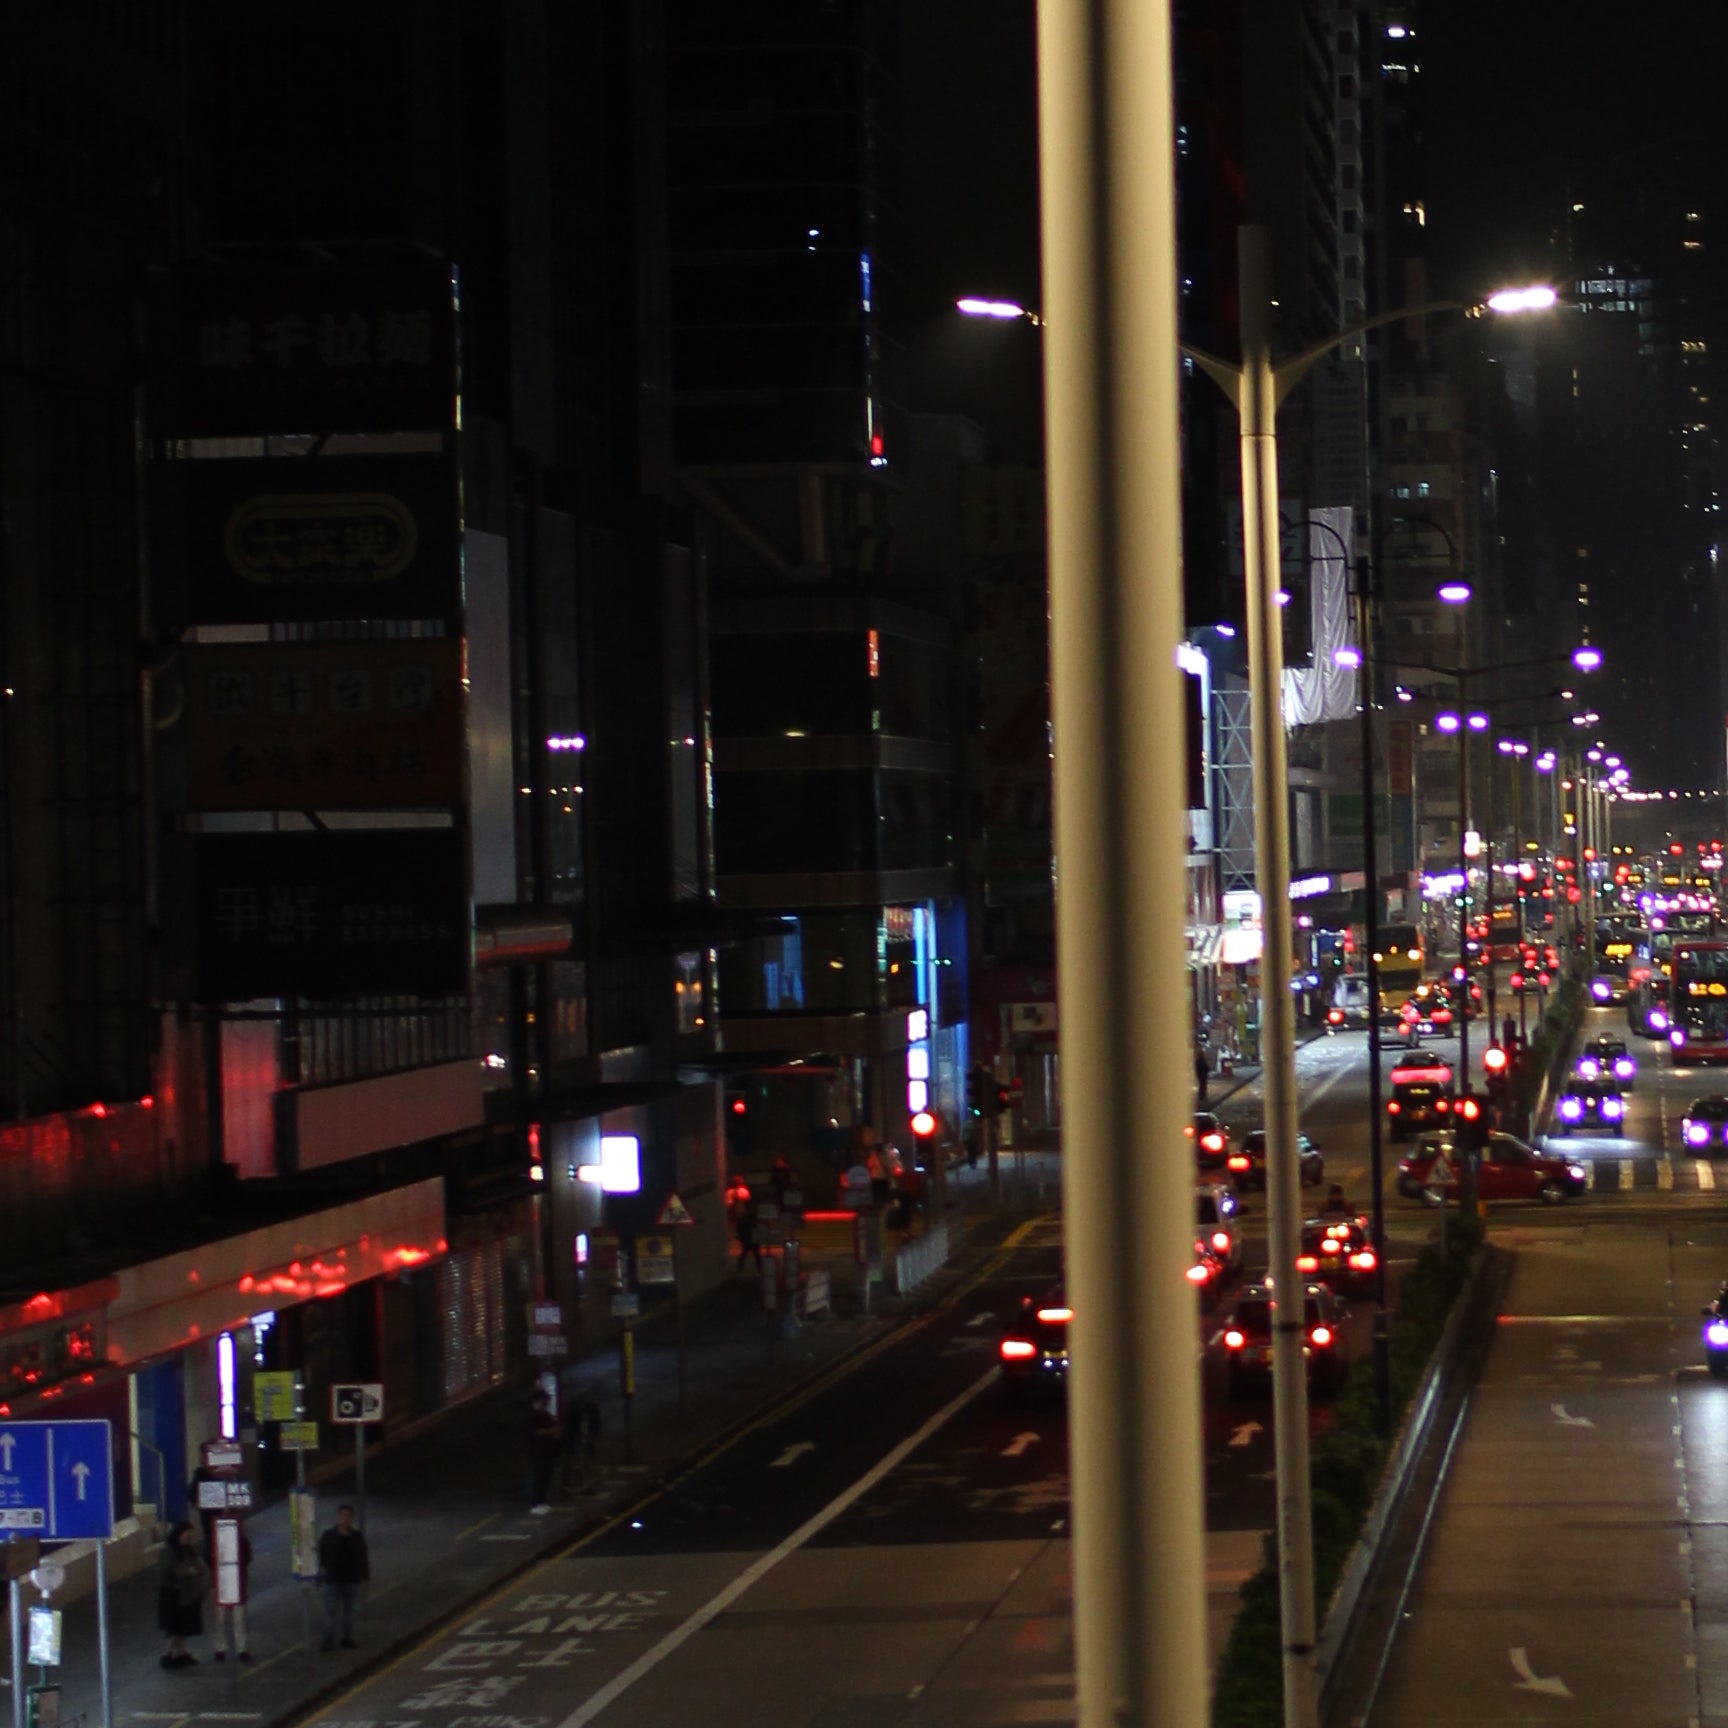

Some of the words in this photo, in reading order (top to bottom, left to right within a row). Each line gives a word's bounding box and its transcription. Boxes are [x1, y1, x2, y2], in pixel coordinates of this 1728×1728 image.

[511, 1590, 669, 1612] BUS
[459, 1612, 658, 1636] LANE
[421, 1637, 596, 1671] 巴士
